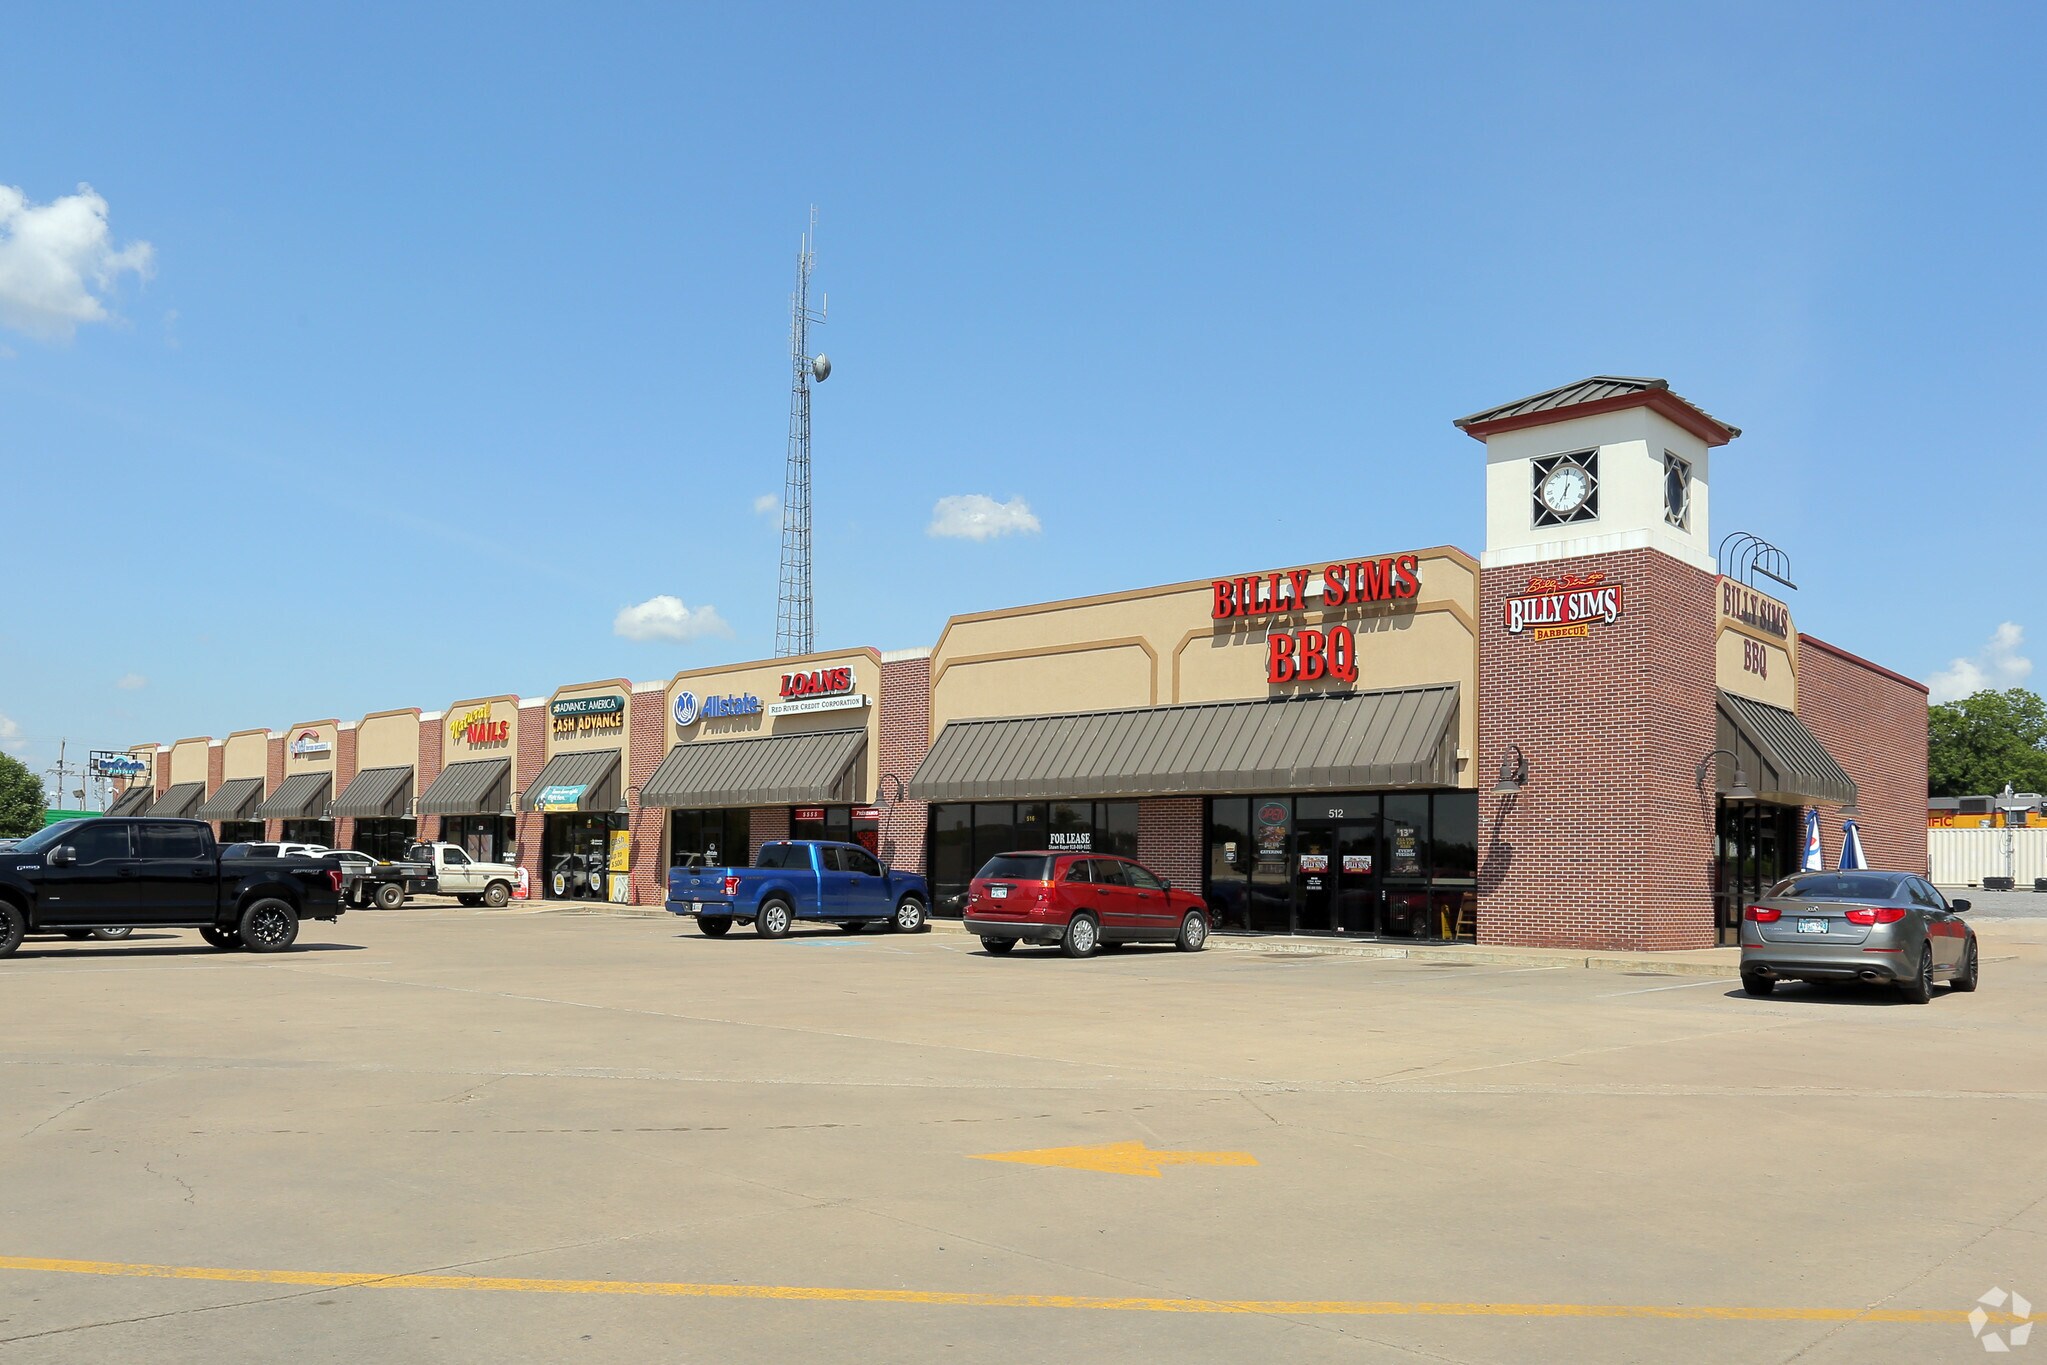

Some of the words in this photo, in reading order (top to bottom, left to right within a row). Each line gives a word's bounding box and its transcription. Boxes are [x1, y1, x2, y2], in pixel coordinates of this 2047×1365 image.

[1211, 569, 1311, 619] BILLY
[1323, 555, 1418, 607] SIMS
[1509, 595, 1565, 633] BILLY
[1568, 588, 1617, 624] SIMS
[1723, 582, 1758, 625] BILLY
[1760, 599, 1788, 640] SIMS
[1537, 626, 1586, 639] BARBECUE
[1267, 625, 1358, 683] BBQ
[1743, 638, 1767, 681] BBQ
[779, 667, 852, 698] LOANS
[559, 701, 586, 712] ADVANCE
[588, 699, 616, 710] AMERICA
[700, 692, 763, 718] Allstate
[800, 702, 820, 710] CREDIT
[821, 698, 860, 708] CORPORATION
[450, 701, 492, 739] Natural
[467, 720, 509, 743] NAILS
[552, 717, 575, 733] CASH
[578, 712, 624, 730] ADVANCE
[1328, 809, 1344, 818] 512
[1050, 833, 1065, 844] FOR
[1066, 833, 1091, 844] LEASE
